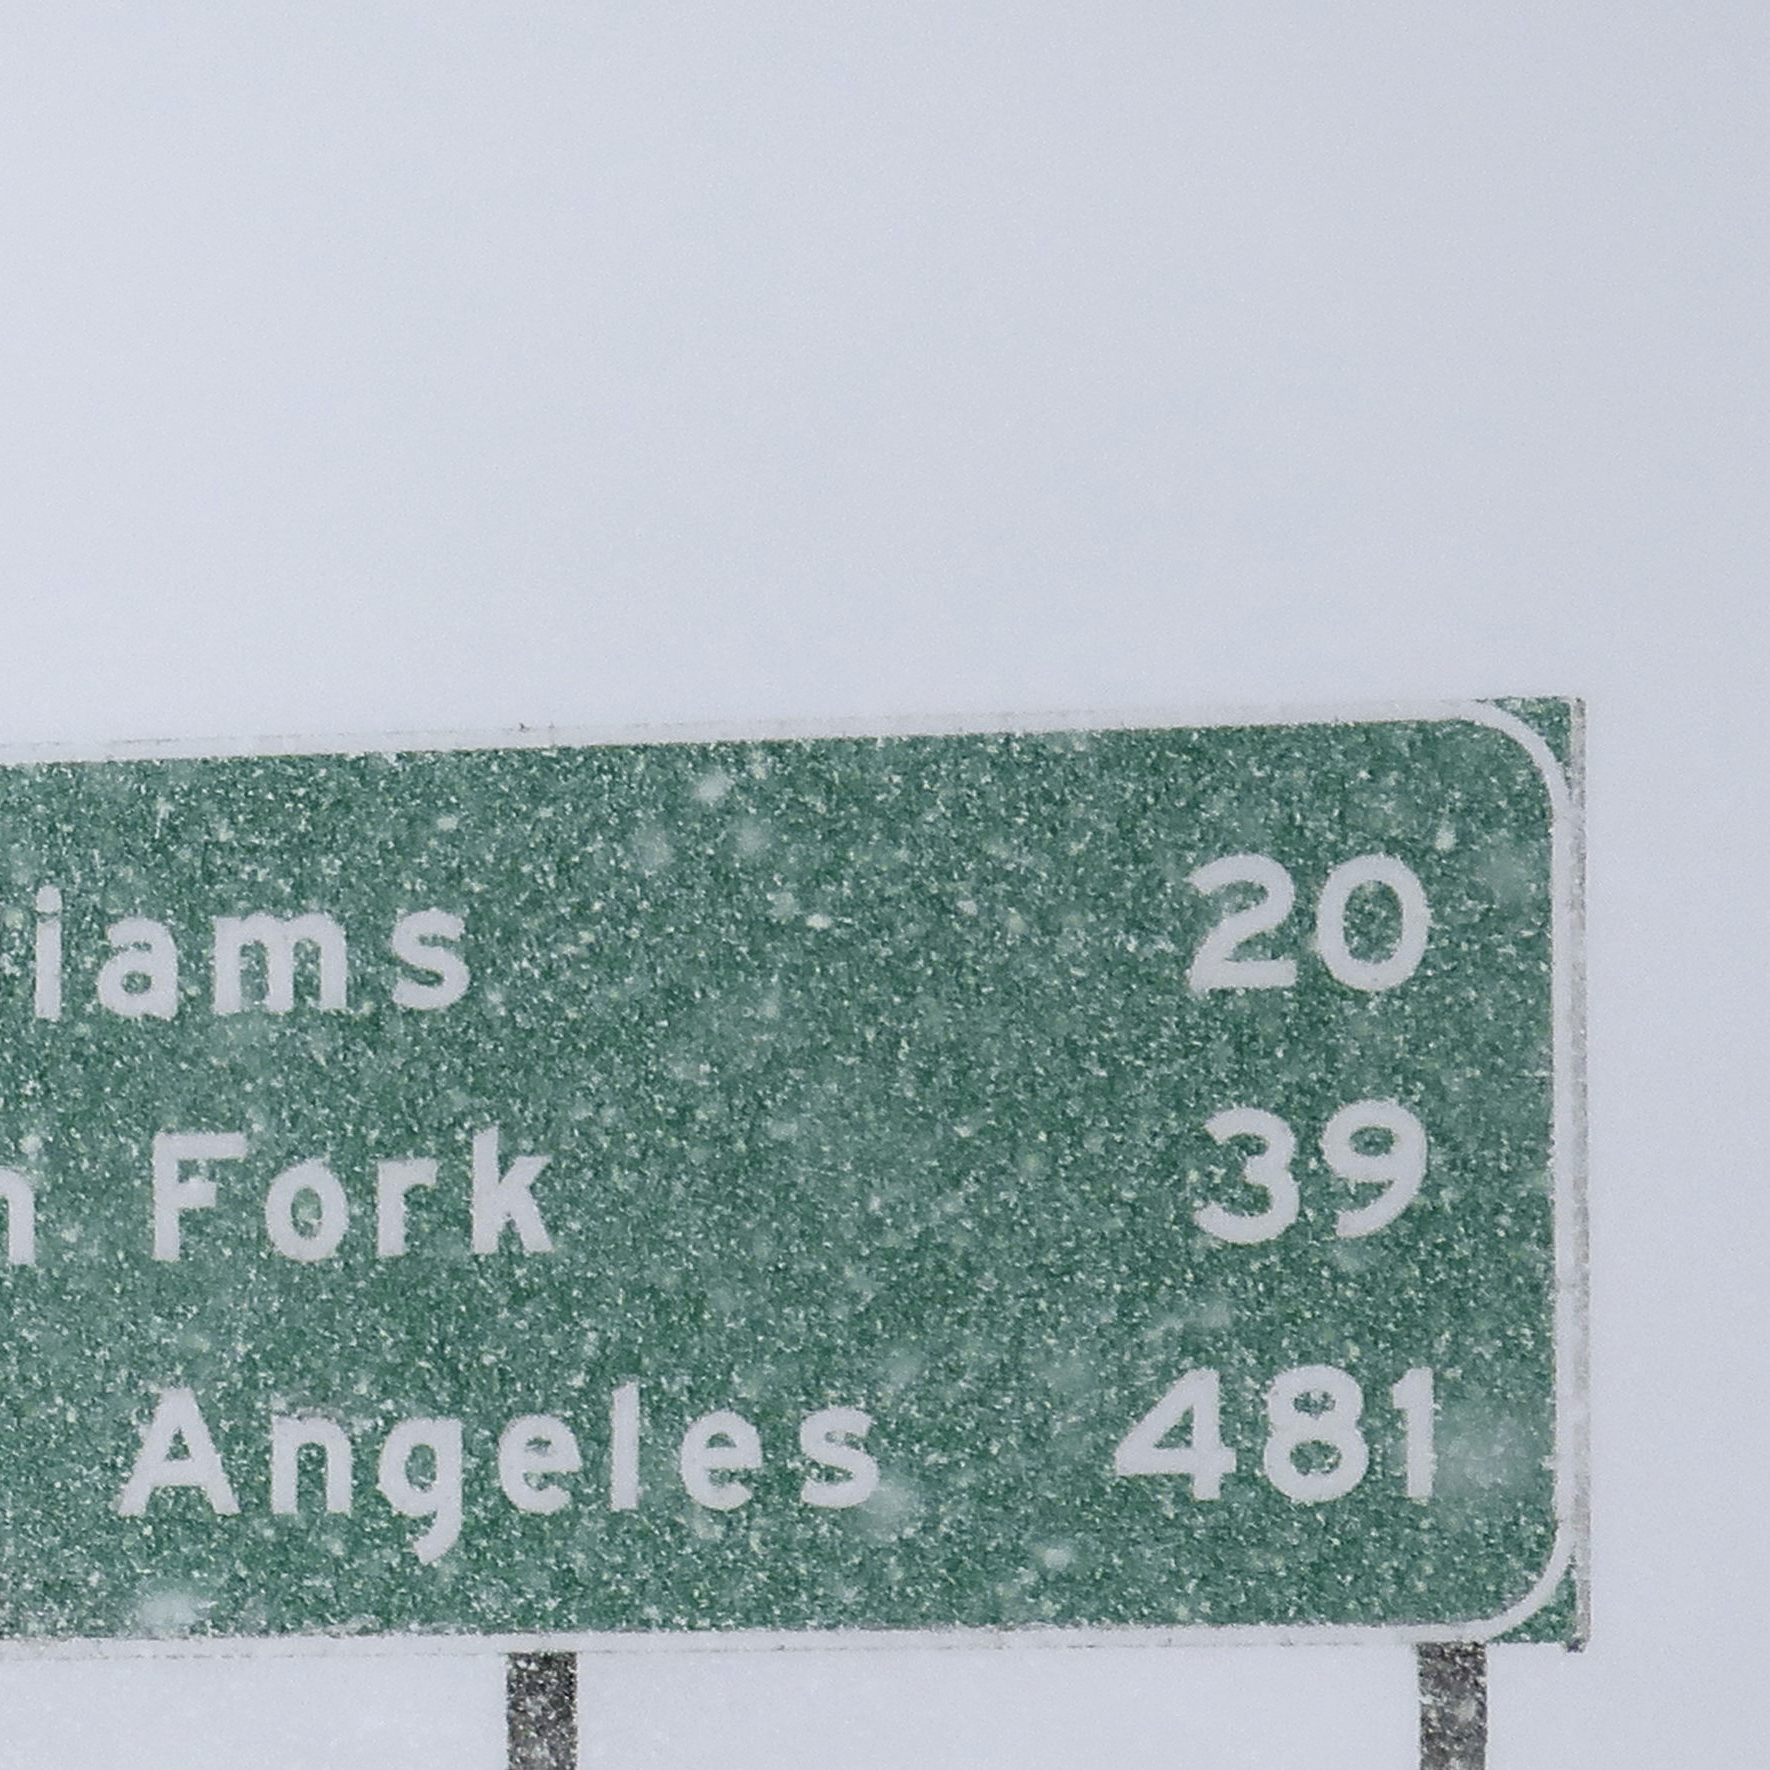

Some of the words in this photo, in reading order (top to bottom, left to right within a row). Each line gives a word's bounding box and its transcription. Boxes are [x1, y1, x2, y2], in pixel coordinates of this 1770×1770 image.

[1183, 853, 1431, 992] 20
[152, 1126, 554, 1261] Fork
[1192, 1099, 1428, 1244] 39
[115, 1382, 882, 1564] Angeles
[1115, 1364, 1438, 1504] 481
